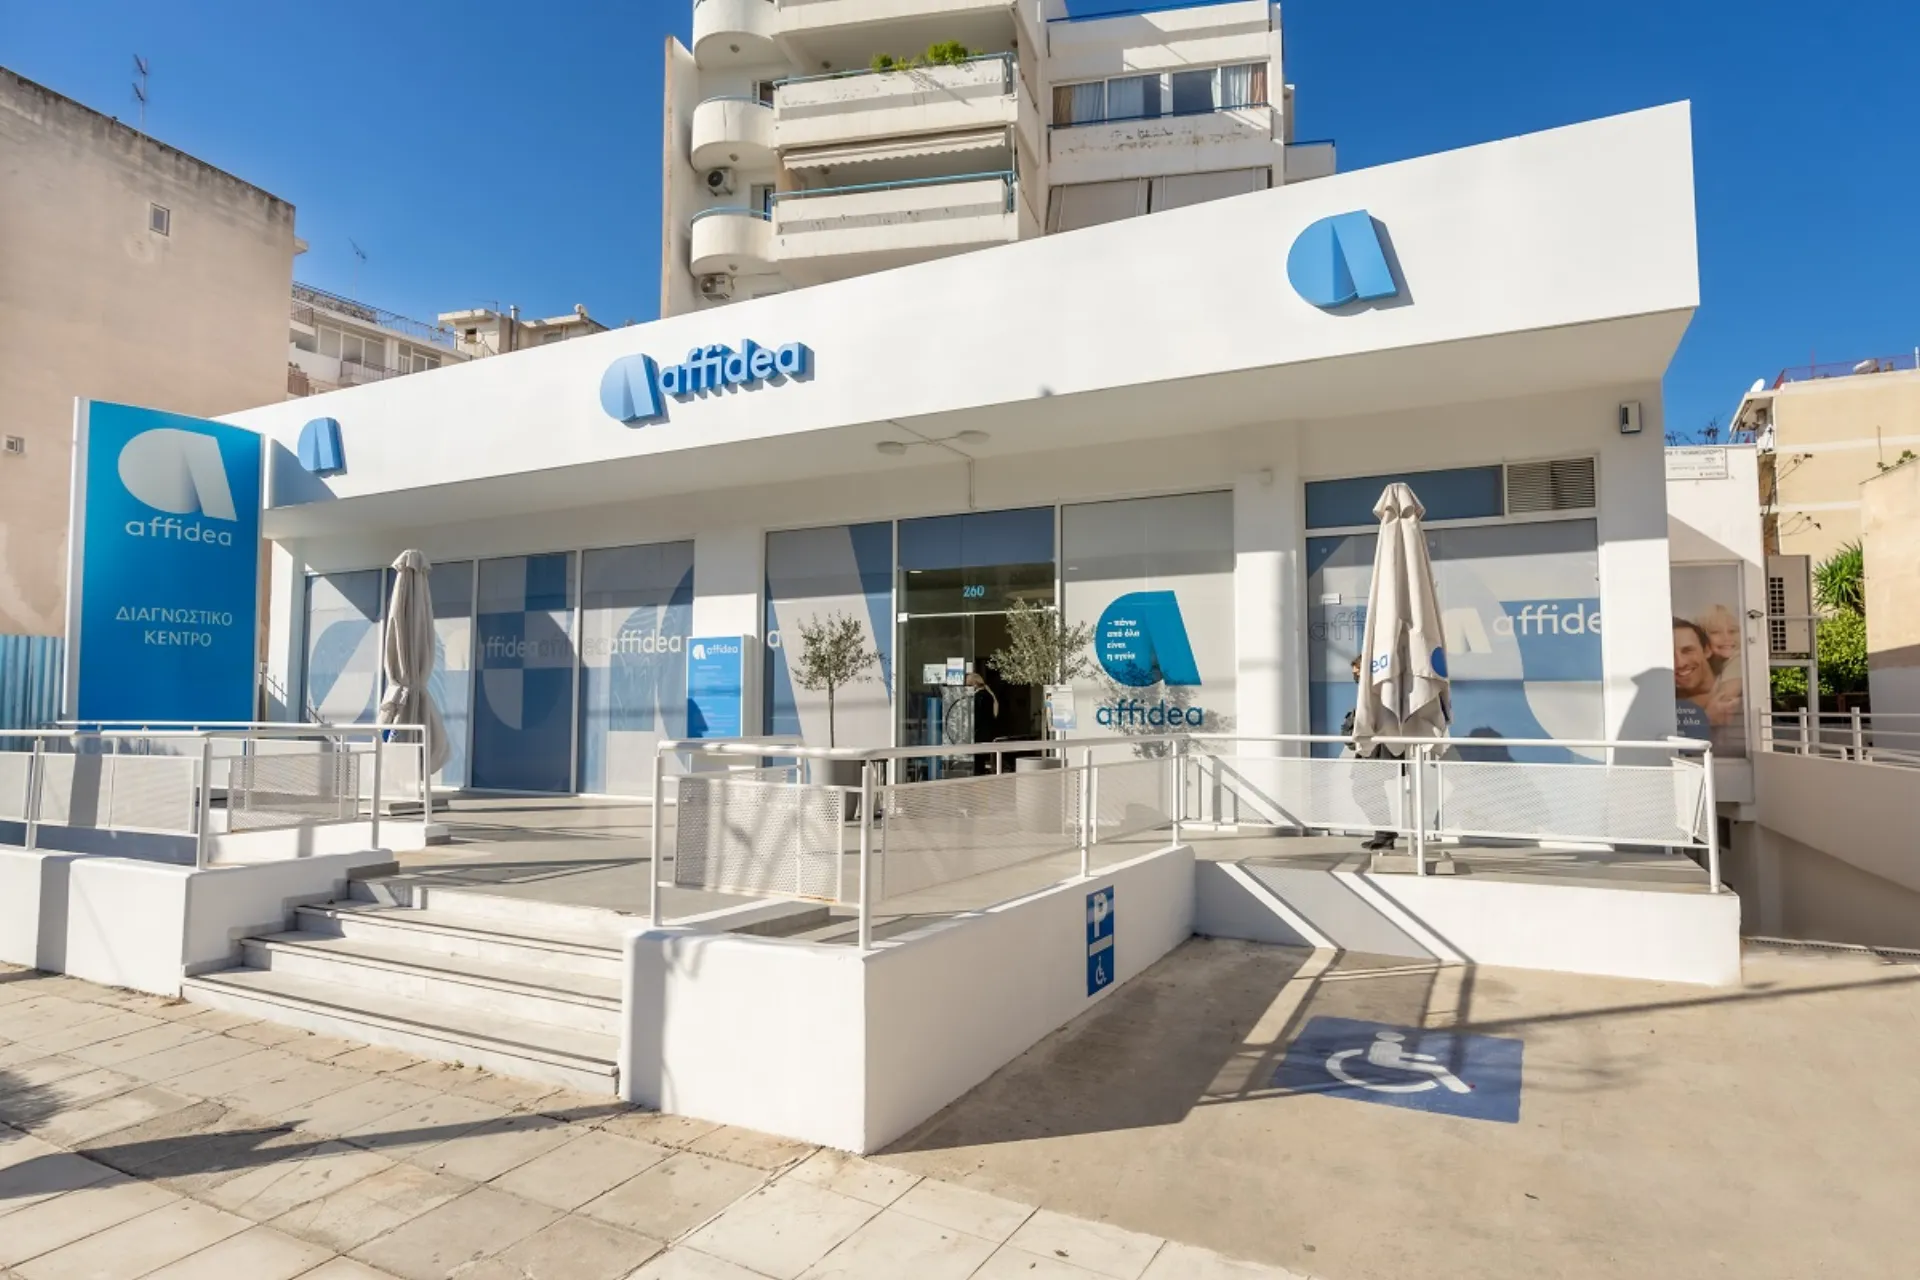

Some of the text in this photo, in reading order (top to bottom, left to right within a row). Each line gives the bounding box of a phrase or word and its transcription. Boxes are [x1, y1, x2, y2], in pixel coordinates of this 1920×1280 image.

[658, 337, 806, 396] affidea
[125, 516, 232, 547] affidea
[963, 584, 985, 598] 260
[115, 605, 233, 628] ΔΙΑΓΝΩΣΤΙΚΟ
[144, 629, 212, 648] ΚΕΝΤΡΟ
[609, 628, 682, 655] affidea
[706, 643, 739, 656] affidea
[1096, 698, 1203, 727] affidea
[1677, 705, 1697, 715] άνω
[1093, 891, 1108, 938] P
